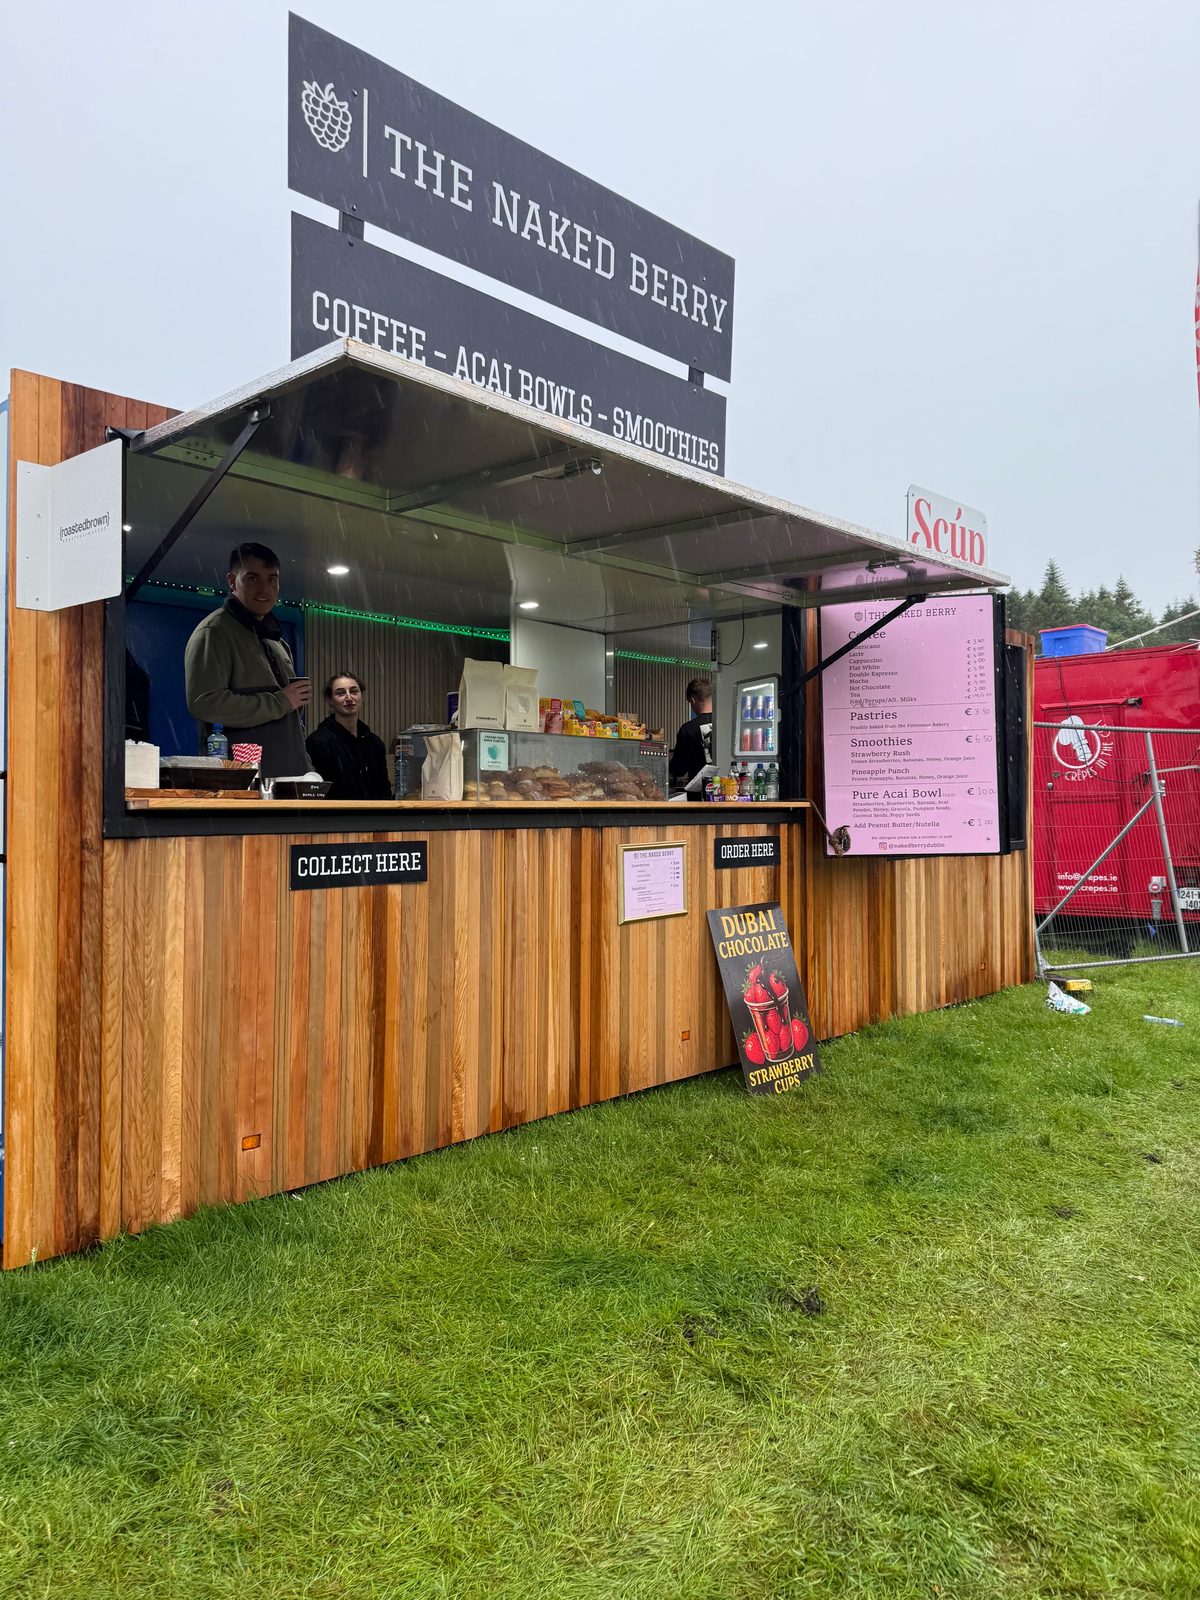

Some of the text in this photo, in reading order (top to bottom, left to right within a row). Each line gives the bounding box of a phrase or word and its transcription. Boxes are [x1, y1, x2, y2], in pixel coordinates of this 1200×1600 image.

[384, 124, 728, 334] THE NAKED BERRY
[312, 290, 426, 366] COFFEE
[452, 345, 512, 398] ACAI
[518, 369, 593, 428] BOWLS
[612, 406, 719, 472] SMOOTHIES
[926, 607, 957, 617] BERRY
[850, 711, 898, 721] Pastries
[965, 708, 972, 716] €
[850, 737, 913, 748] Smoothies
[966, 735, 972, 743] €
[1101, 742, 1114, 756] THE
[1096, 757, 1108, 769] IN
[853, 790, 879, 800] Pure
[882, 788, 908, 798] Acai
[912, 788, 942, 798] Bowl
[967, 788, 974, 796] €
[892, 820, 940, 828] Butter/Nutella
[721, 843, 774, 859] ORDER HERE
[297, 852, 421, 877] COLLECT HERE
[1185, 900, 1200, 908] 140
[720, 909, 777, 938] DUBAI
[719, 931, 789, 959] CHOCOLATE
[749, 1053, 815, 1087] STRAWBERRY
[774, 1074, 801, 1094] CUPS
